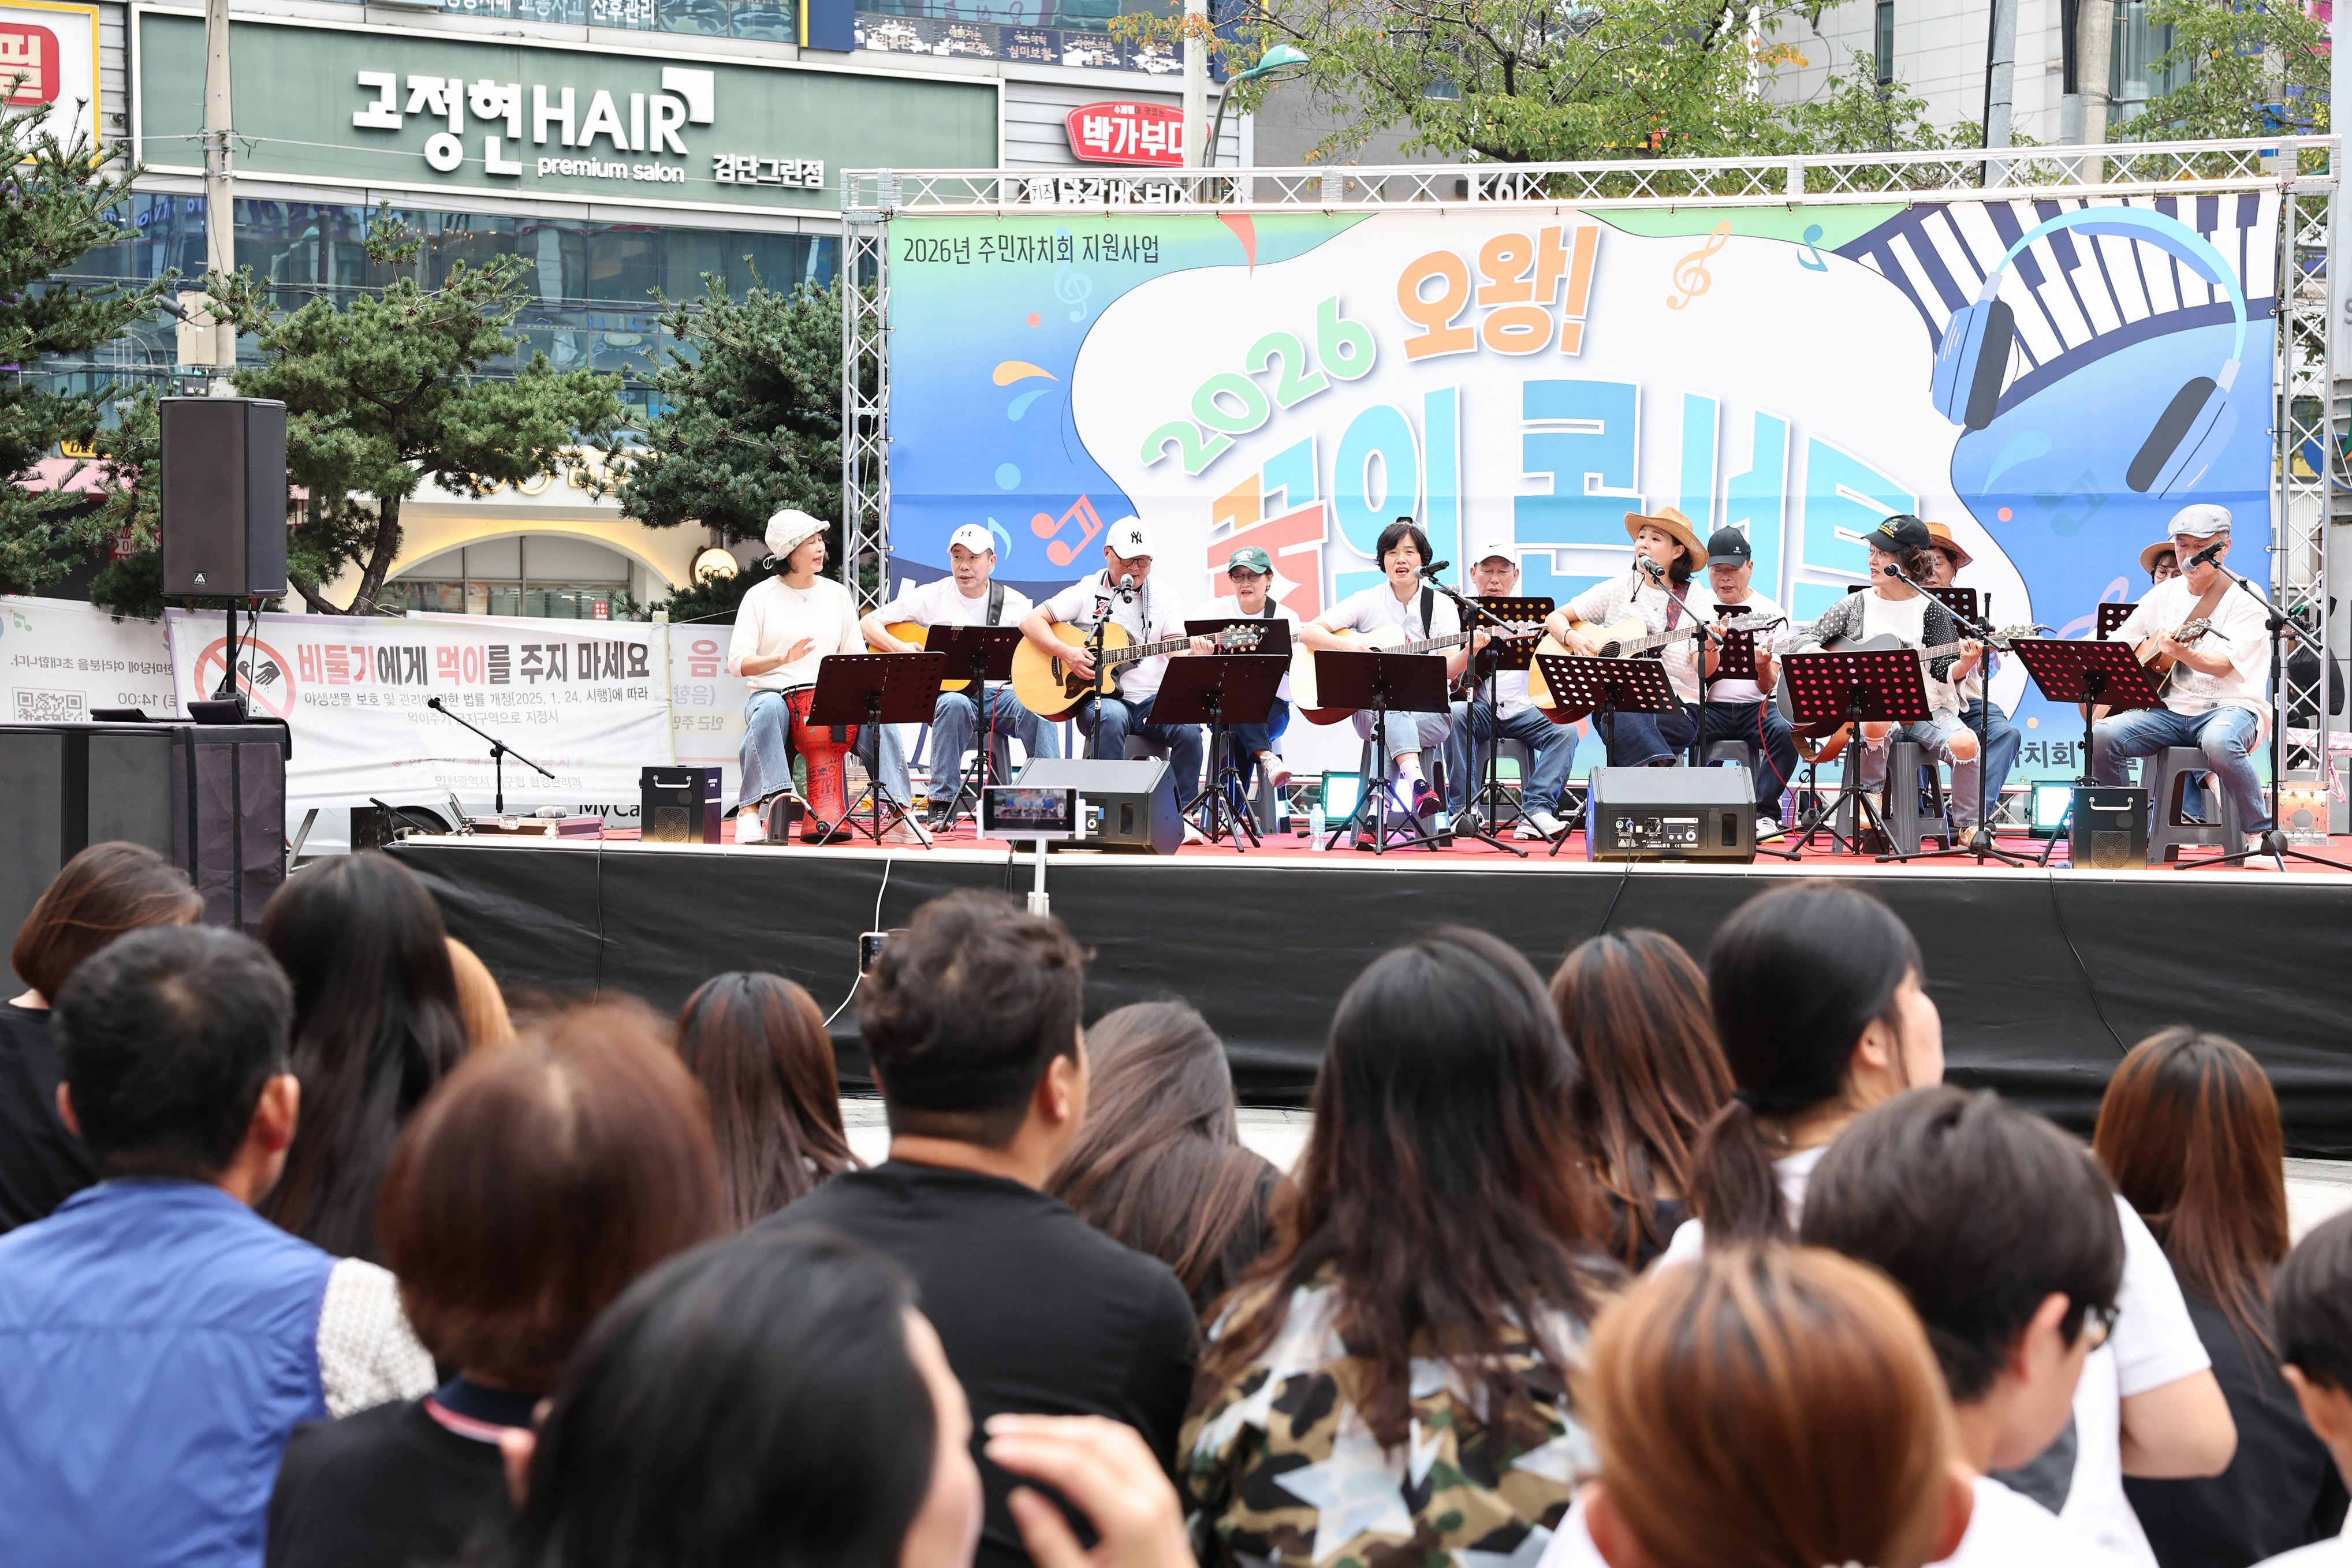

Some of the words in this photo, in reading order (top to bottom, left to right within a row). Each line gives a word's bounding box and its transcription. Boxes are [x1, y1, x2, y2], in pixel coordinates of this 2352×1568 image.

[353, 70, 522, 176] 고정현
[533, 84, 690, 155] HAIR
[538, 156, 628, 180] premium
[633, 161, 685, 183] salon
[713, 154, 825, 188] 검단그린점
[903, 236, 971, 264] 2026년
[978, 234, 1074, 264] 주민자치회
[1082, 233, 1159, 264] 지원사업
[1139, 292, 1377, 477] 2026
[1395, 223, 1601, 363] 오왕!
[1512, 375, 1921, 628] 콘서트
[297, 643, 428, 686] 비둘기에게
[437, 645, 511, 686] 먹이를
[520, 643, 568, 685] 주지
[577, 640, 650, 681] 마세요
[304, 691, 352, 707] 야생생물
[356, 693, 381, 707] 보호
[383, 693, 396, 707] 및
[463, 692, 486, 707] 법률
[551, 692, 561, 704] 1.
[565, 690, 582, 703] 24.
[586, 687, 623, 703] 시행]에
[627, 685, 648, 701] 따라
[408, 711, 452, 726] 먹이주기
[526, 710, 559, 723] 지정시
[435, 775, 490, 788] 인천광역시
